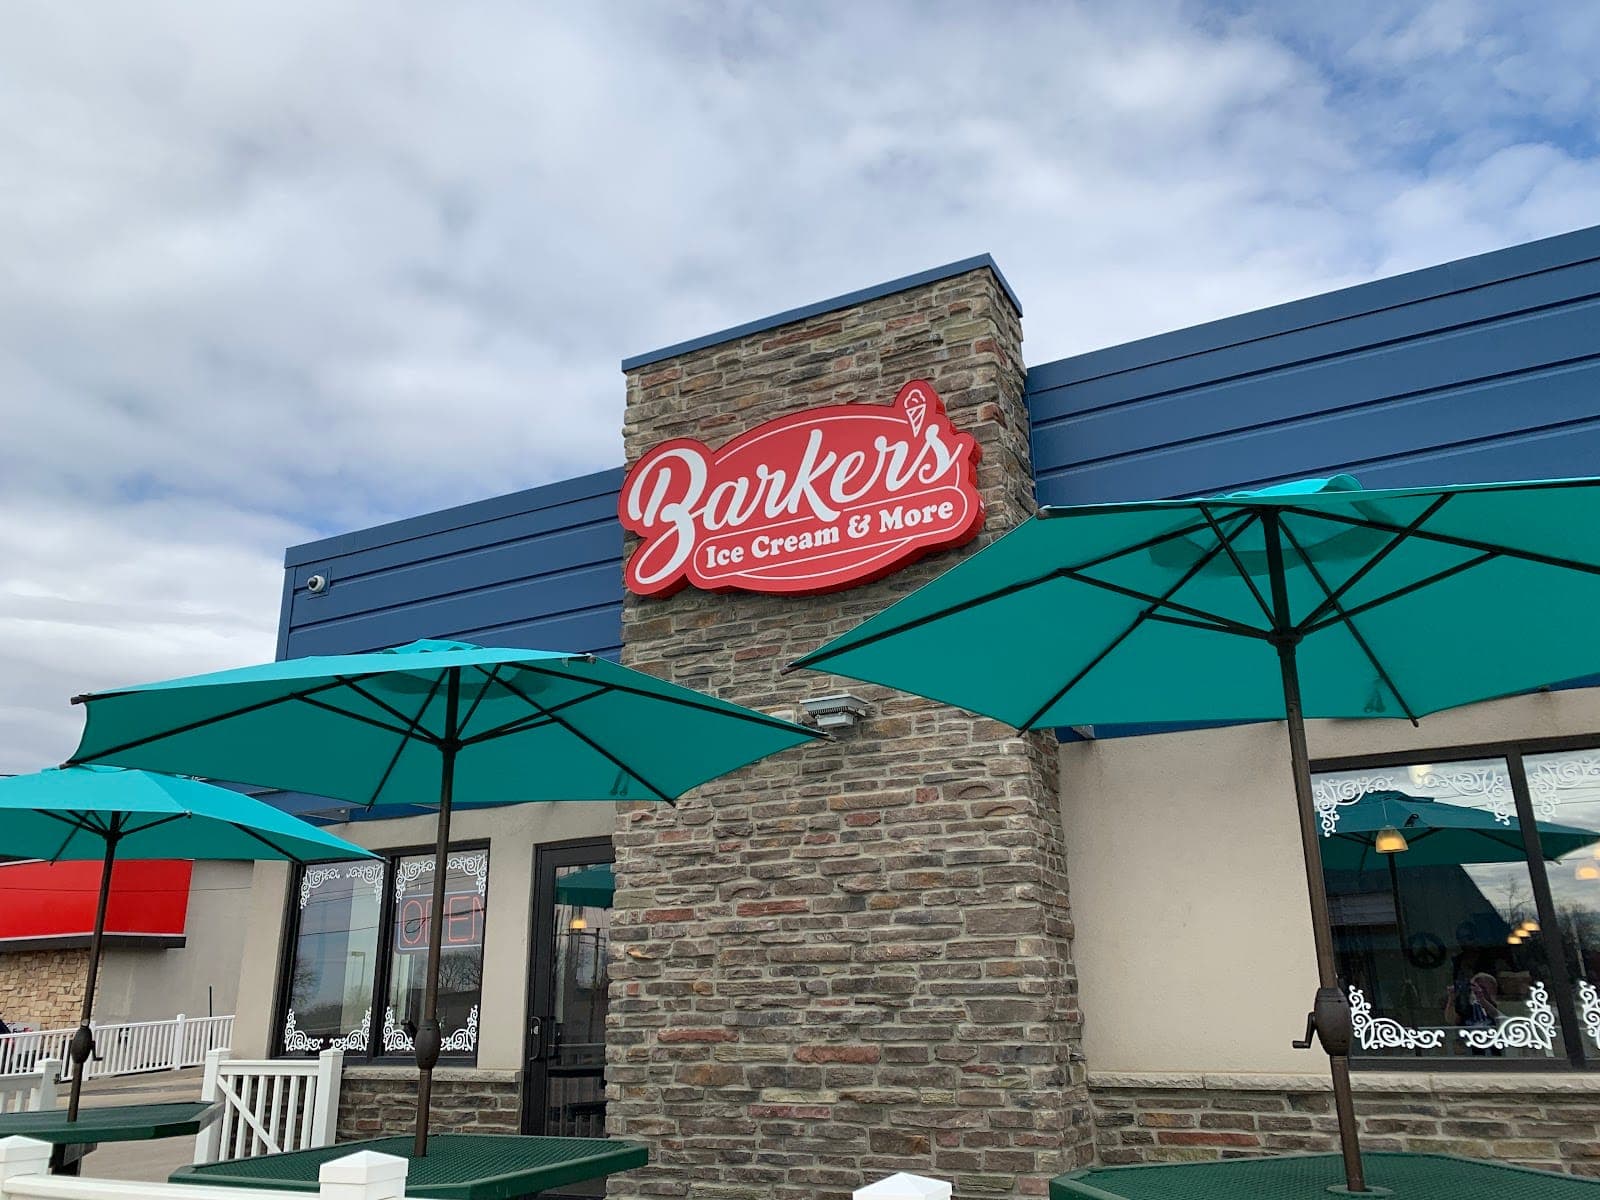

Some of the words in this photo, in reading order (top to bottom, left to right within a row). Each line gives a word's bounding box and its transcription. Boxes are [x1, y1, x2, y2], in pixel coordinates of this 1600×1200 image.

[705, 545, 745, 569] Ice
[750, 525, 841, 559] Cream
[846, 513, 872, 539] &
[878, 500, 955, 534] More
